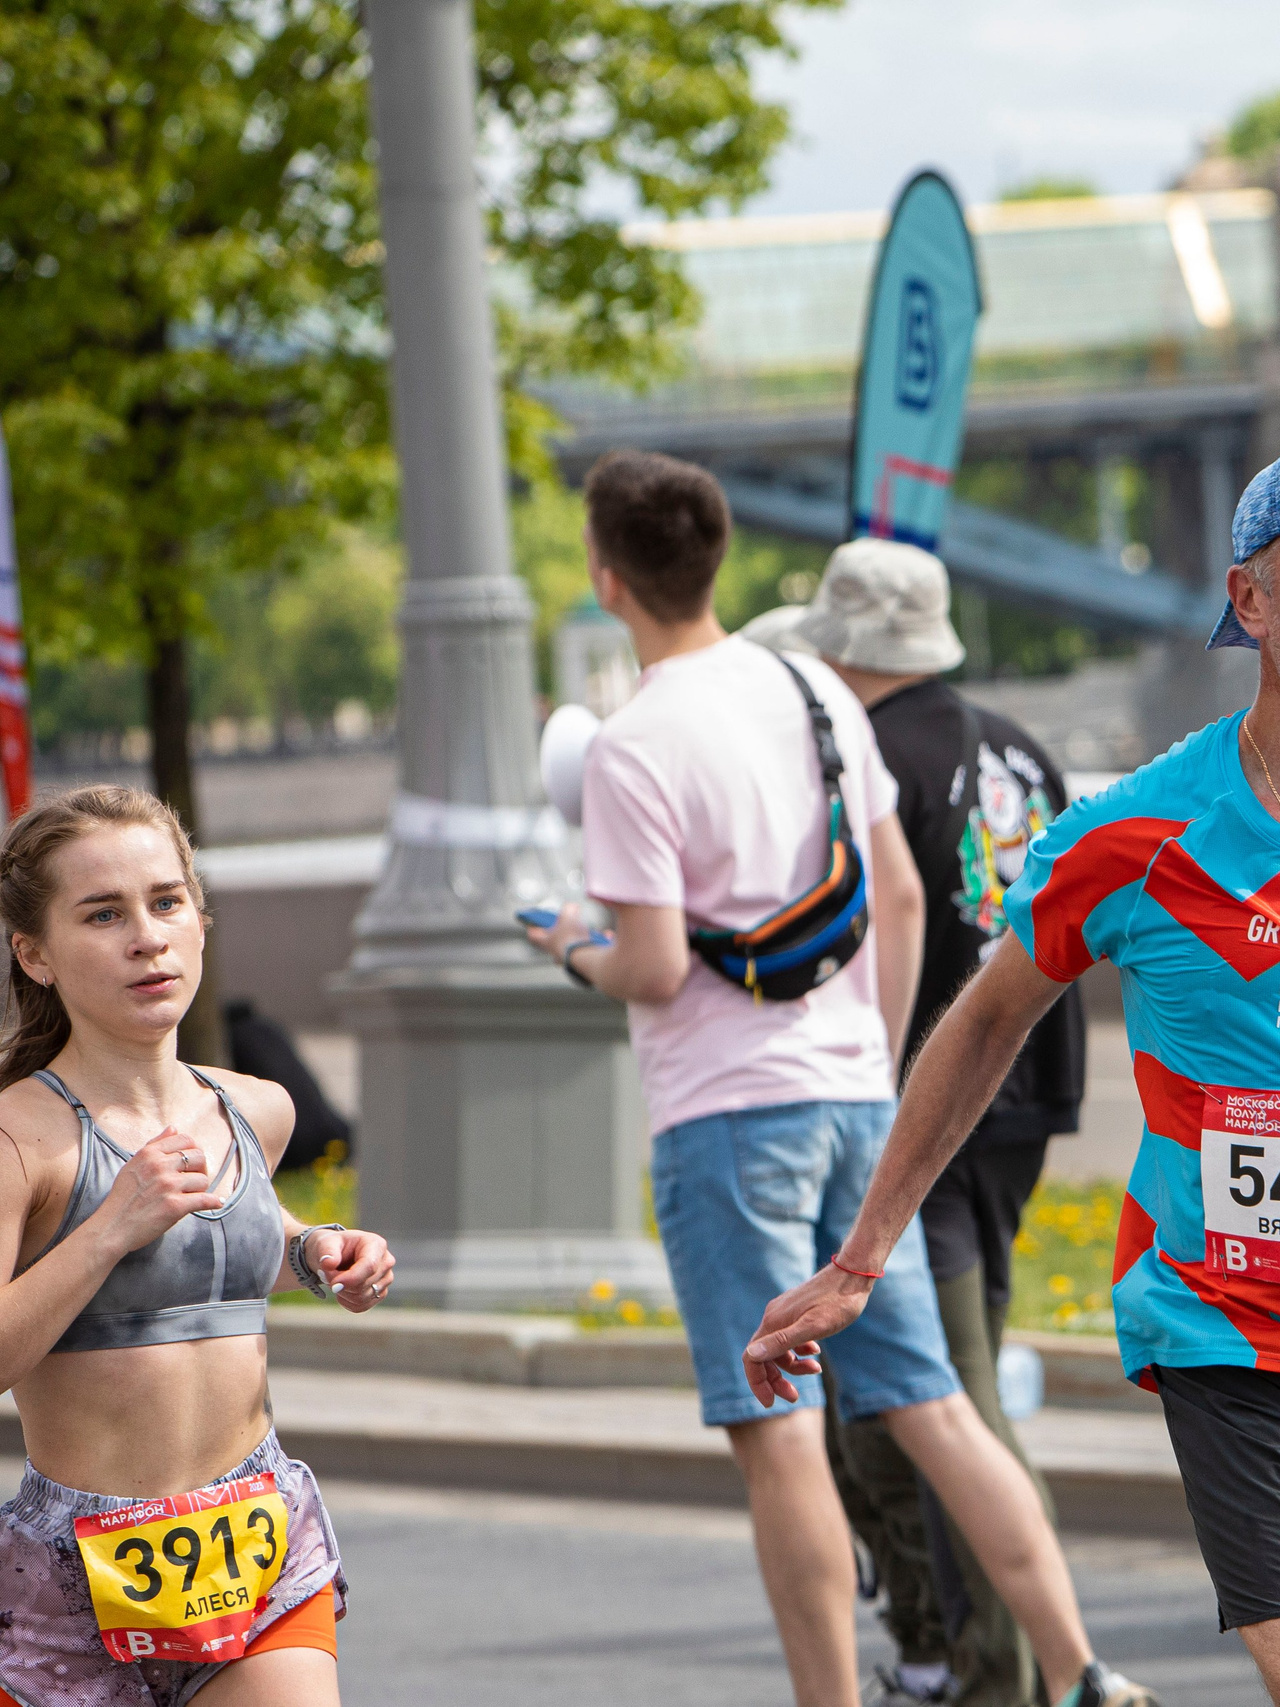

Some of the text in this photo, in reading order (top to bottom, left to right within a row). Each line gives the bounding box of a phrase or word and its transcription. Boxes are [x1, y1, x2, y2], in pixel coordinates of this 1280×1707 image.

[1225, 1106, 1257, 1119] ПОЛУ
[248, 1482, 265, 1493] 2023
[100, 1504, 165, 1528] МАРАФОН
[114, 1507, 277, 1603] 3913
[184, 1586, 250, 1620] АЛЕСЯ
